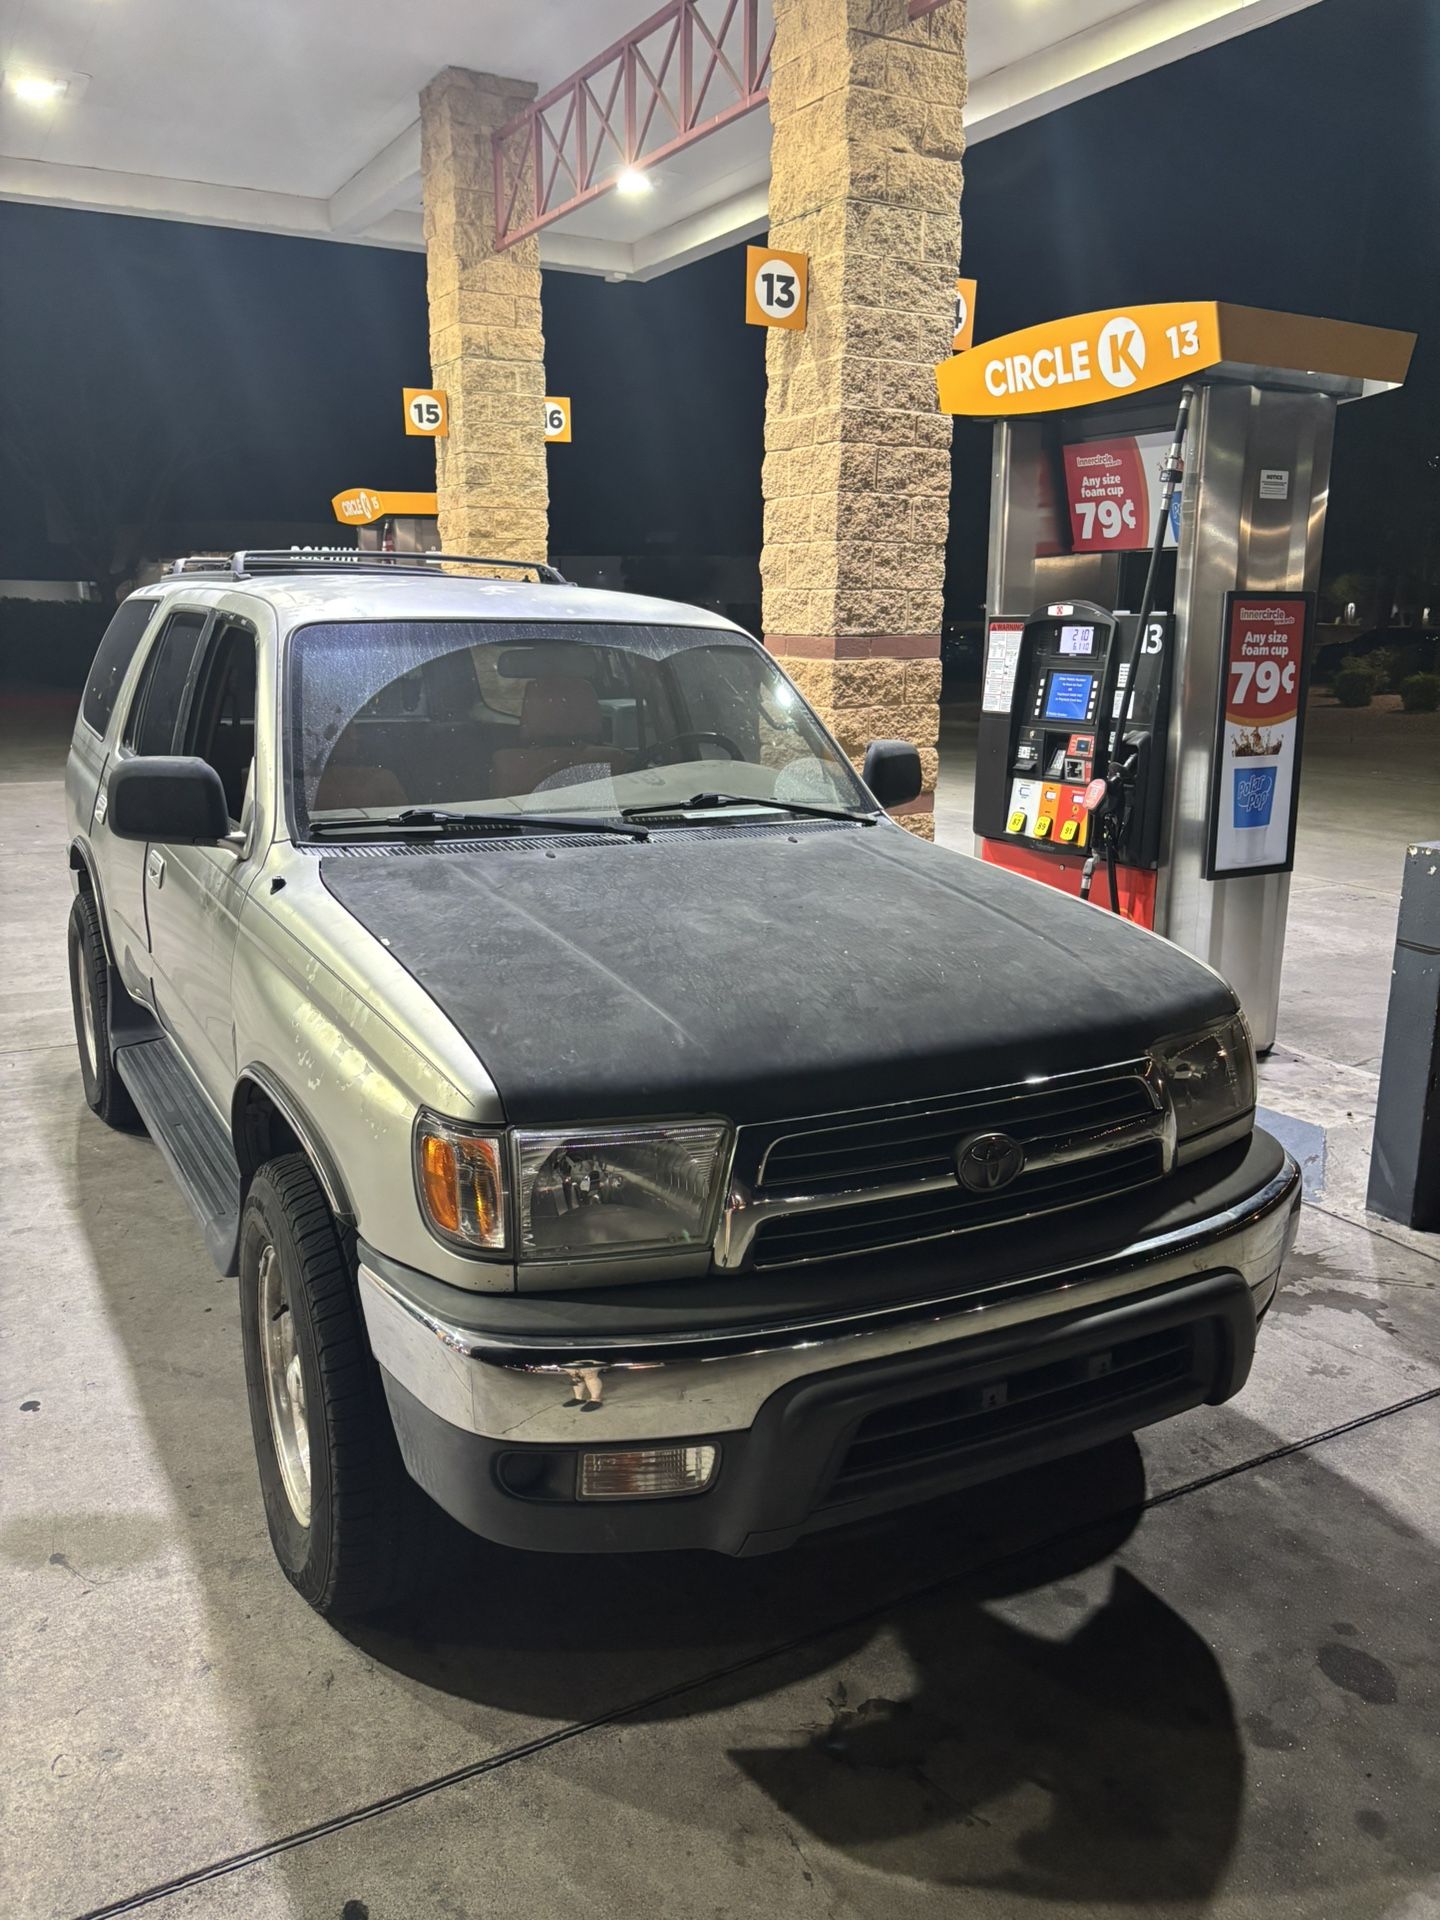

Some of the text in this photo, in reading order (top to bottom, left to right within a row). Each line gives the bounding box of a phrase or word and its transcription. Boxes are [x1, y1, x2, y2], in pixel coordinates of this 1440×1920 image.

[761, 273, 795, 308] 13
[985, 320, 1199, 396] CIRCLE K 13
[413, 404, 440, 424] 15
[1082, 473, 1121, 488] Any size
[1081, 486, 1124, 498] foam cup
[341, 498, 363, 517] CIRCLE
[1074, 499, 1136, 539] 79¢
[997, 623, 1024, 631] WARNING
[1140, 623, 1163, 654] 13
[1244, 630, 1288, 645] Any size
[1241, 644, 1288, 658] foam cup
[1231, 661, 1296, 704] 79¢
[1237, 774, 1266, 799] Polar
[1246, 791, 1268, 812] Pop
